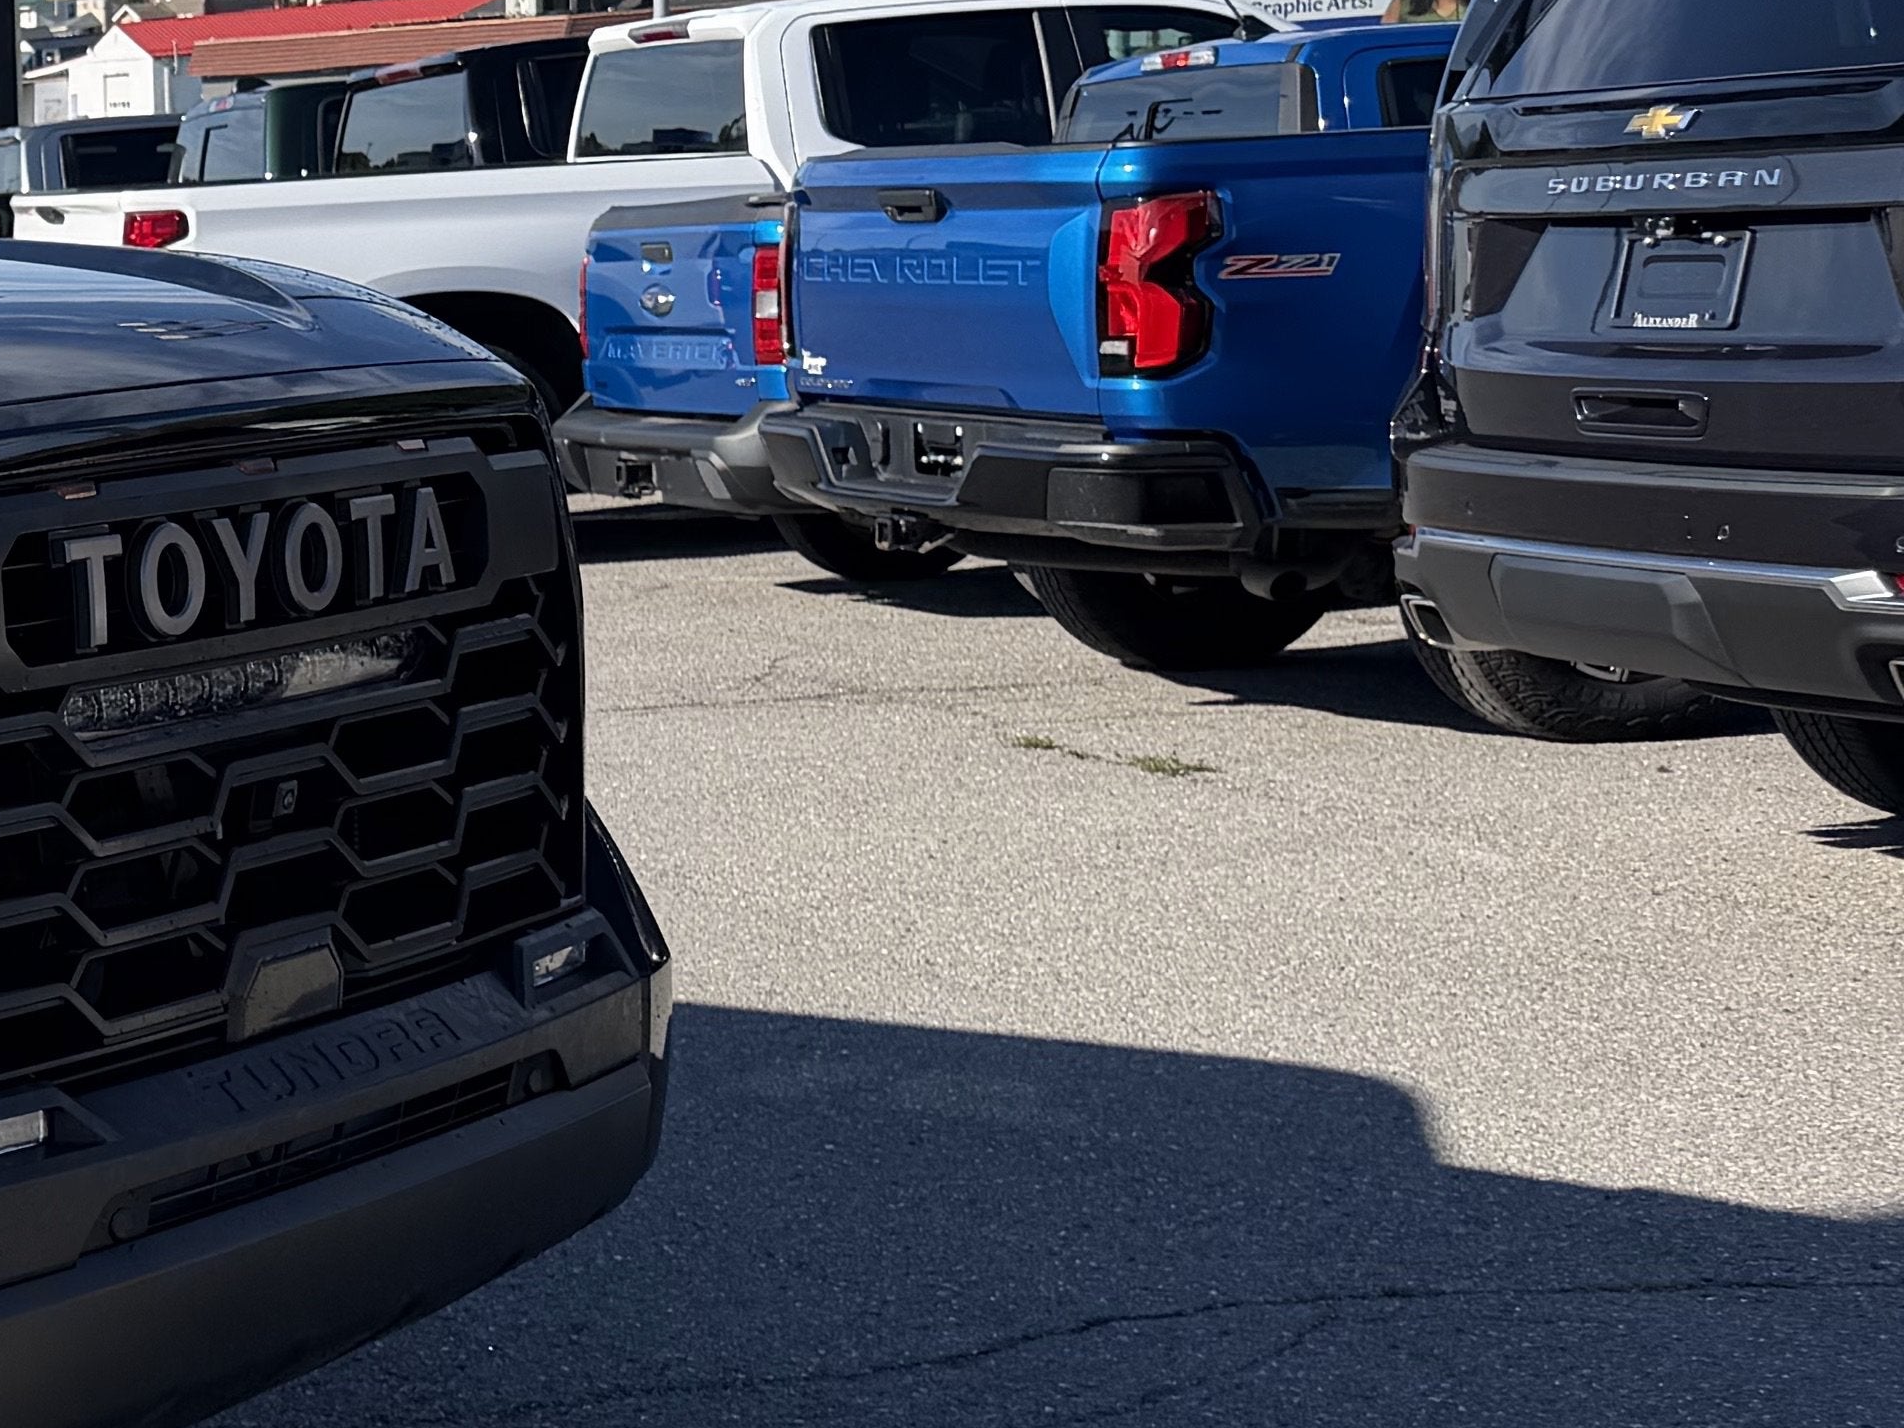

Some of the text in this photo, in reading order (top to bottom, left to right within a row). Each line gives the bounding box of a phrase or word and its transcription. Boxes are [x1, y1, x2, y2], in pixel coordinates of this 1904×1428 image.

[1546, 168, 1781, 194] SUBURBAN
[803, 255, 1042, 286] CHEVROLET
[1218, 253, 1341, 279] Z71
[63, 486, 456, 647] TOYOTA
[195, 1006, 462, 1113] TUNDRA
